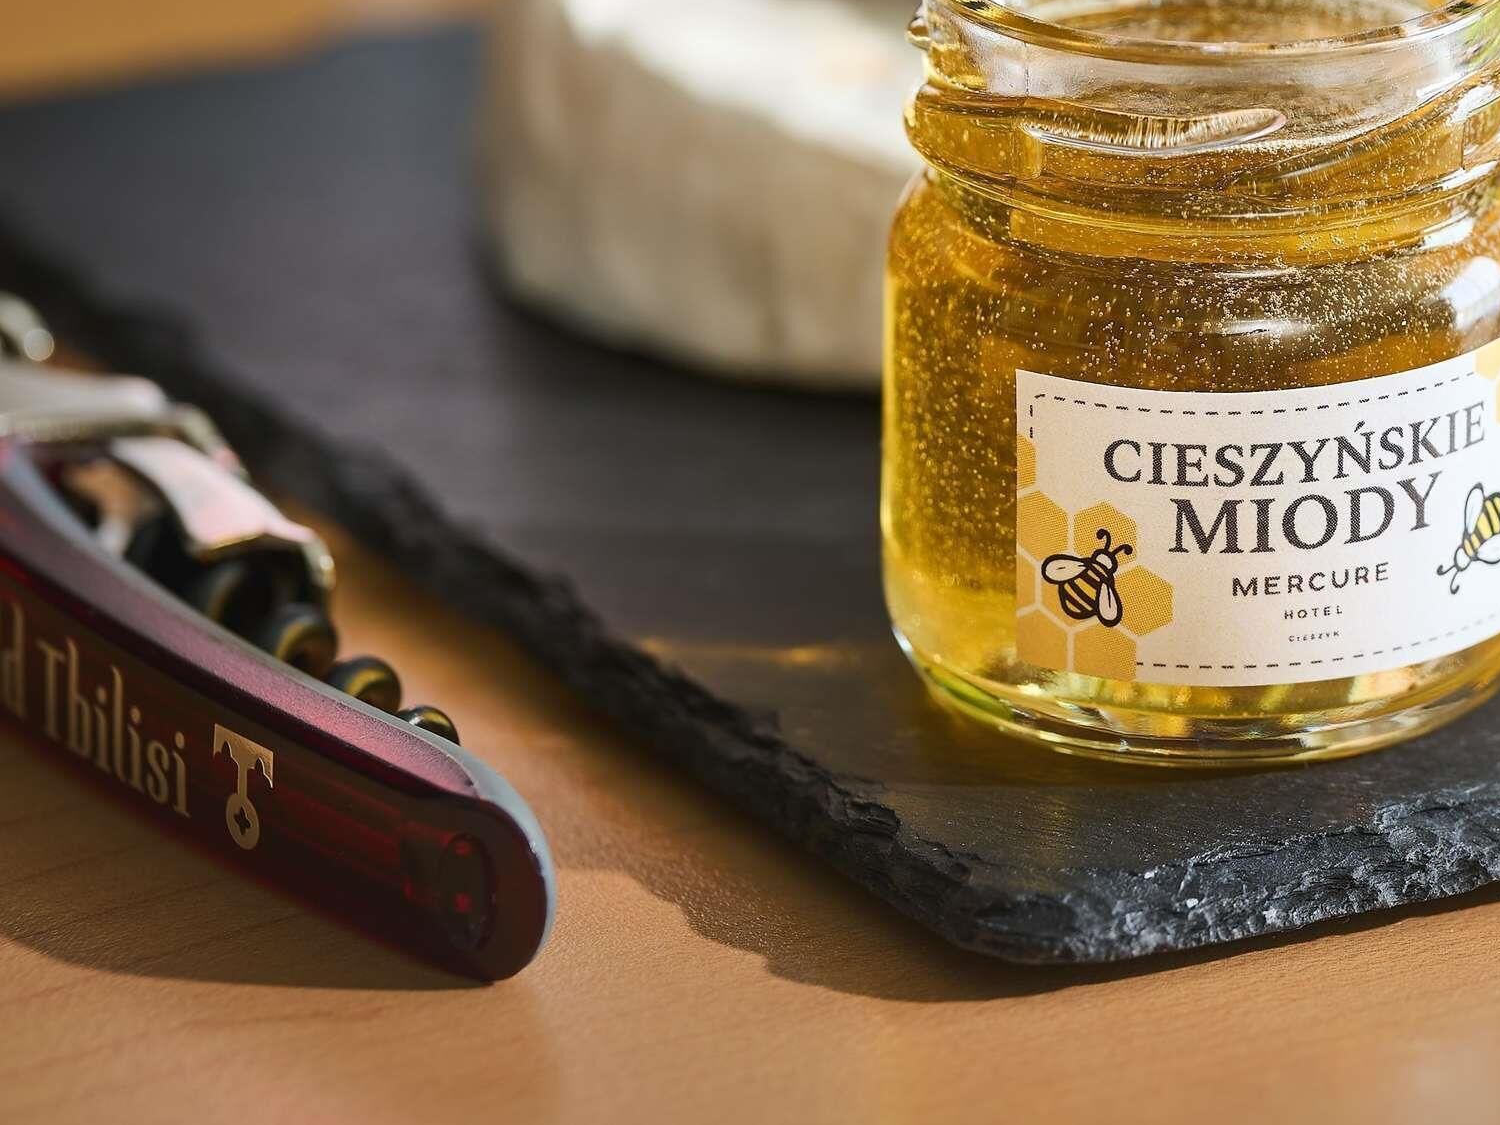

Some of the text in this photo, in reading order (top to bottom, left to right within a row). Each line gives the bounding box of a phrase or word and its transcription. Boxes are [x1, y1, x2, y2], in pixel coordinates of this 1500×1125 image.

[1103, 401, 1486, 488] CIESZYŃSKIE
[1169, 471, 1443, 554] MIODY
[1231, 562, 1390, 597] MERCURE
[1283, 605, 1343, 620] HOTEL
[36, 635, 190, 818] Tbilisi
